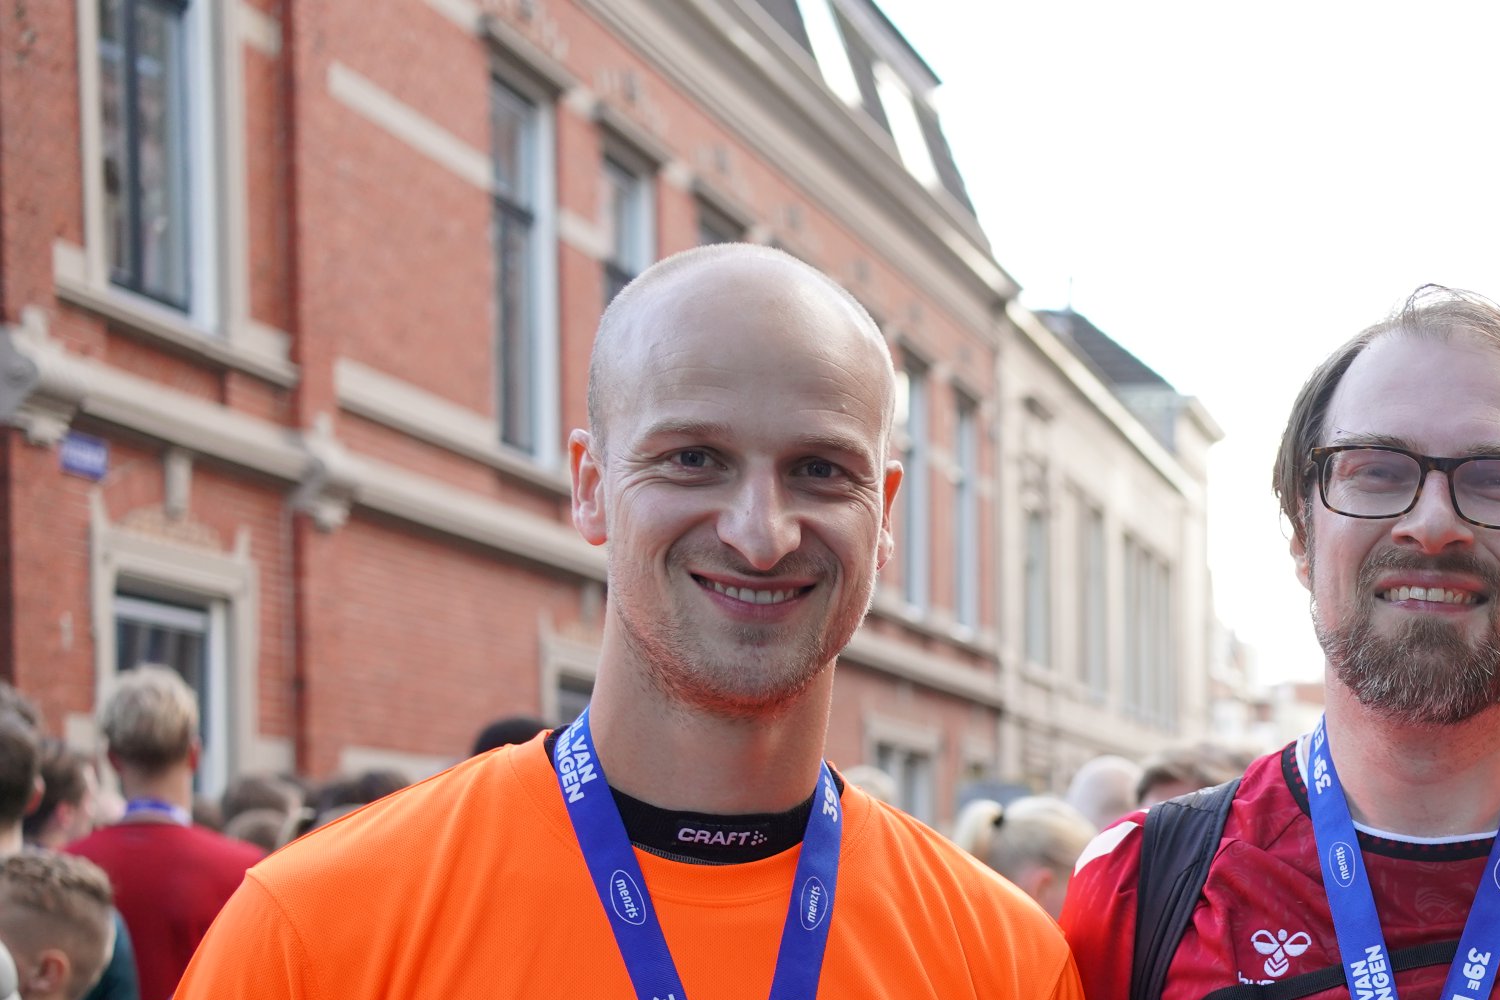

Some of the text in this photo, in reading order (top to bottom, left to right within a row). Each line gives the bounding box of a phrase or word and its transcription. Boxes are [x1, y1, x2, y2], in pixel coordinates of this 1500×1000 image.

[571, 734, 598, 785] VAN
[677, 828, 751, 846] CRAFT
[1334, 846, 1350, 881] menzis
[615, 878, 639, 919] menzis
[807, 884, 821, 923] menzis
[1463, 947, 1491, 991] 39E
